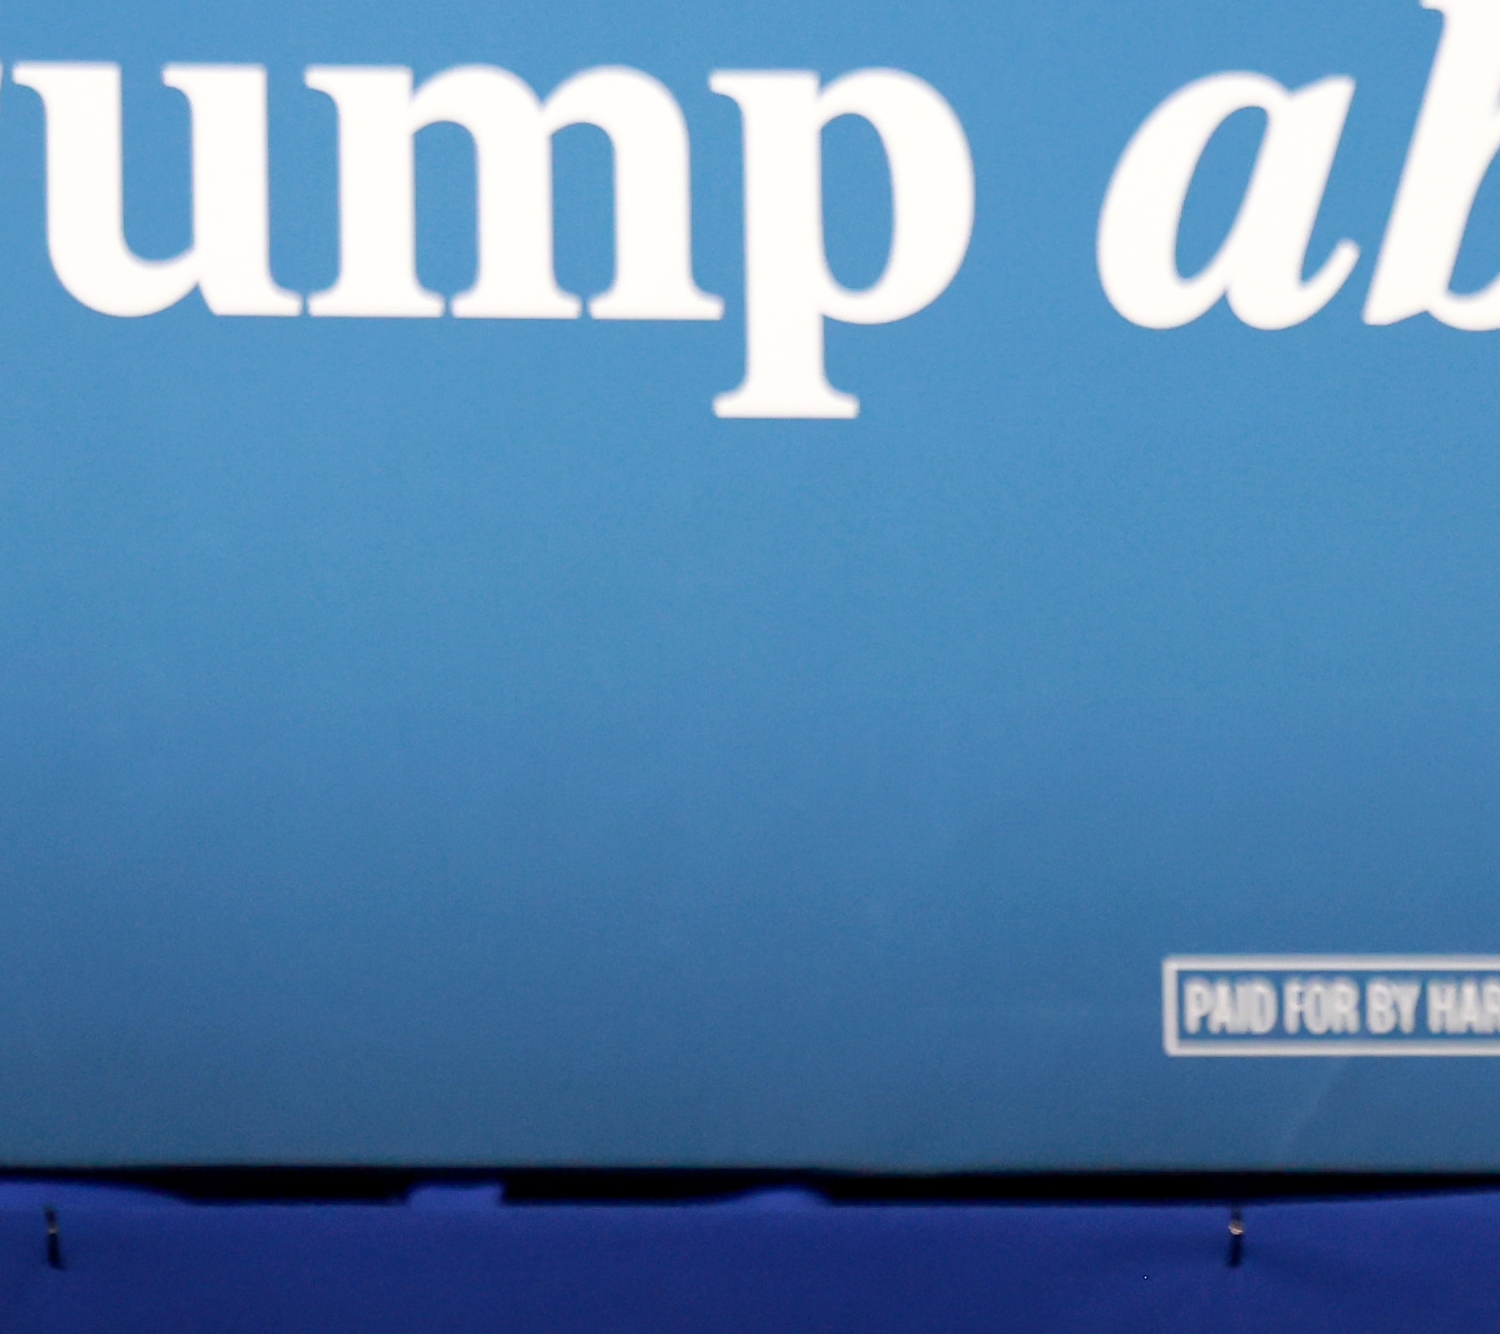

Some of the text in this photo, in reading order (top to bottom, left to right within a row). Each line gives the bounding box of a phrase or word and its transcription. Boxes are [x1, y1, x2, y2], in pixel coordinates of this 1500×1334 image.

[1184, 978, 1277, 1034] PAID
[1284, 978, 1360, 1034] FOR
[1366, 979, 1420, 1033] BY
